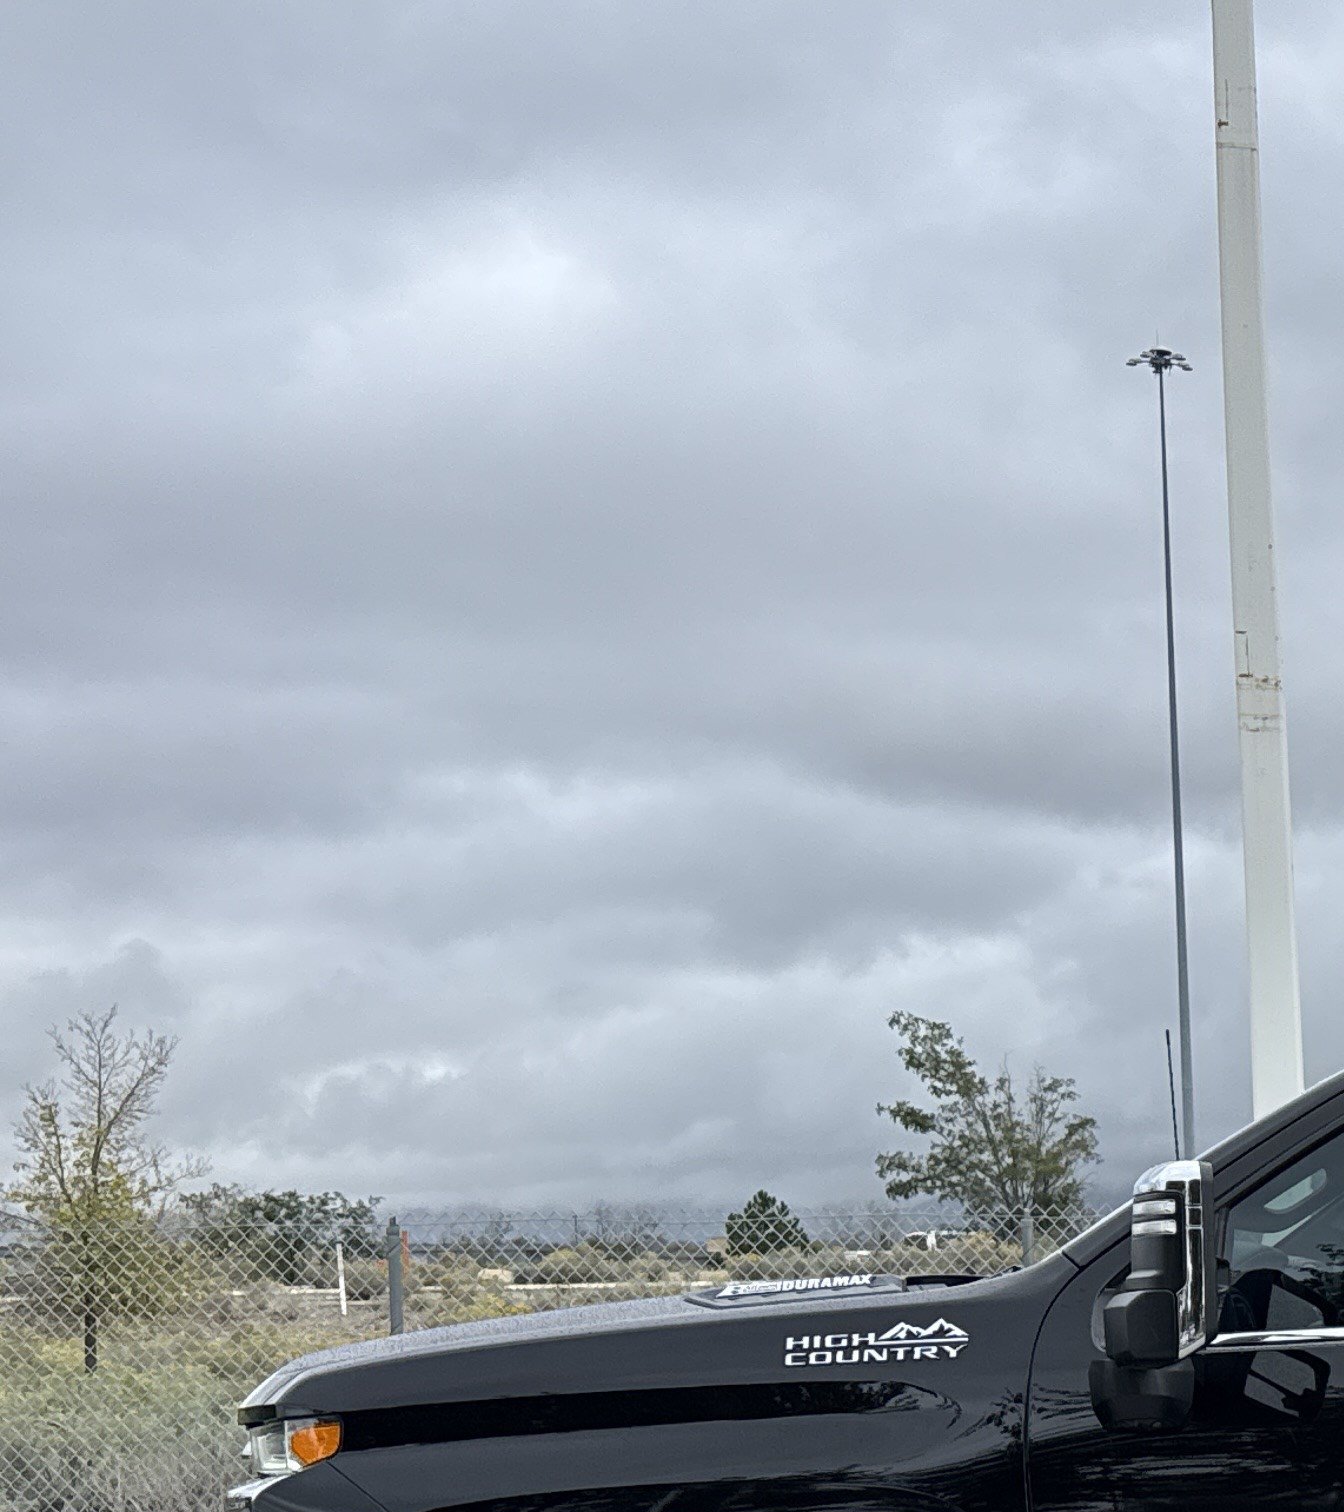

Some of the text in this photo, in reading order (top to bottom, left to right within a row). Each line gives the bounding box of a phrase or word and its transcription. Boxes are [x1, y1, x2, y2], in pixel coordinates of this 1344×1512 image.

[782, 1274, 872, 1291] DURAMAX
[785, 1332, 876, 1350] HIGH
[784, 1343, 968, 1366] COUNTRY
